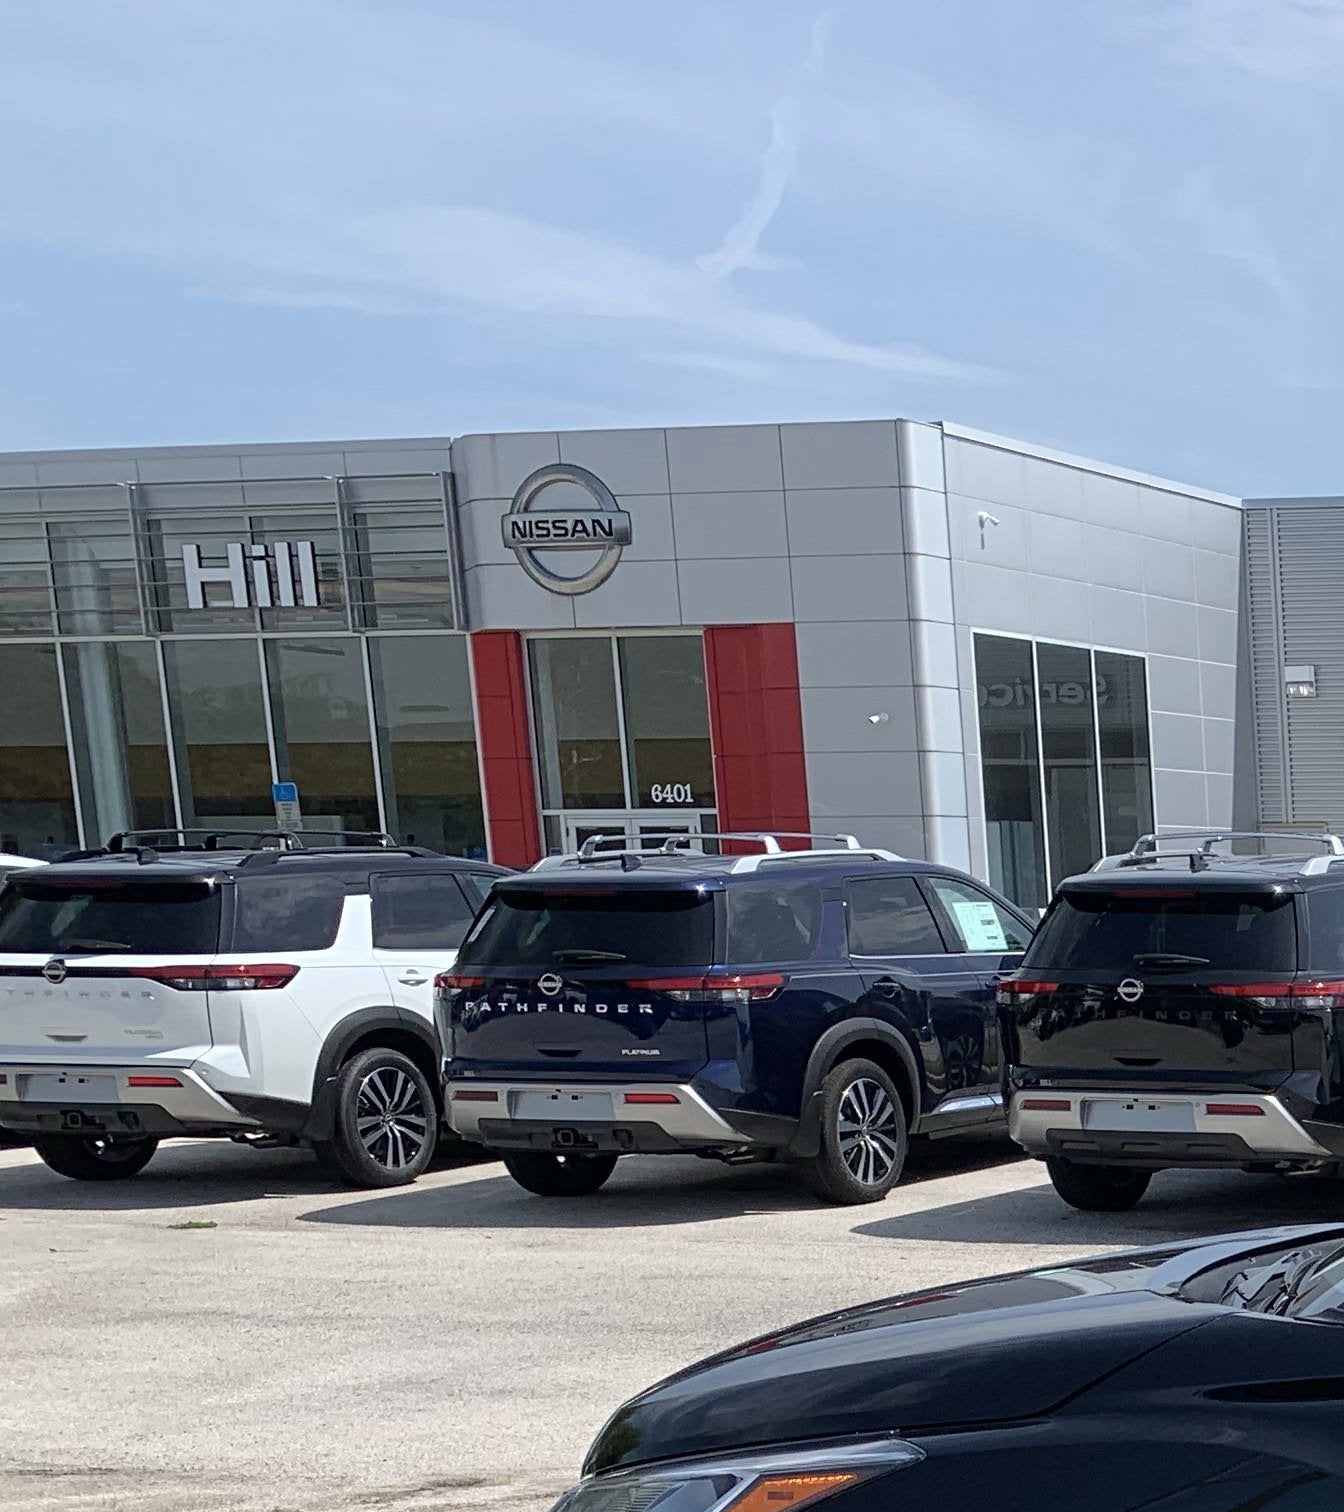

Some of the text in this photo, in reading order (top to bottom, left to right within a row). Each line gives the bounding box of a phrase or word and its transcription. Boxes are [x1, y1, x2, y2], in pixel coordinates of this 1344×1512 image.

[511, 518, 614, 538] NISSAN
[182, 540, 319, 609] Hill
[651, 783, 694, 803] 6401
[465, 1001, 653, 1014] PATHFINDER
